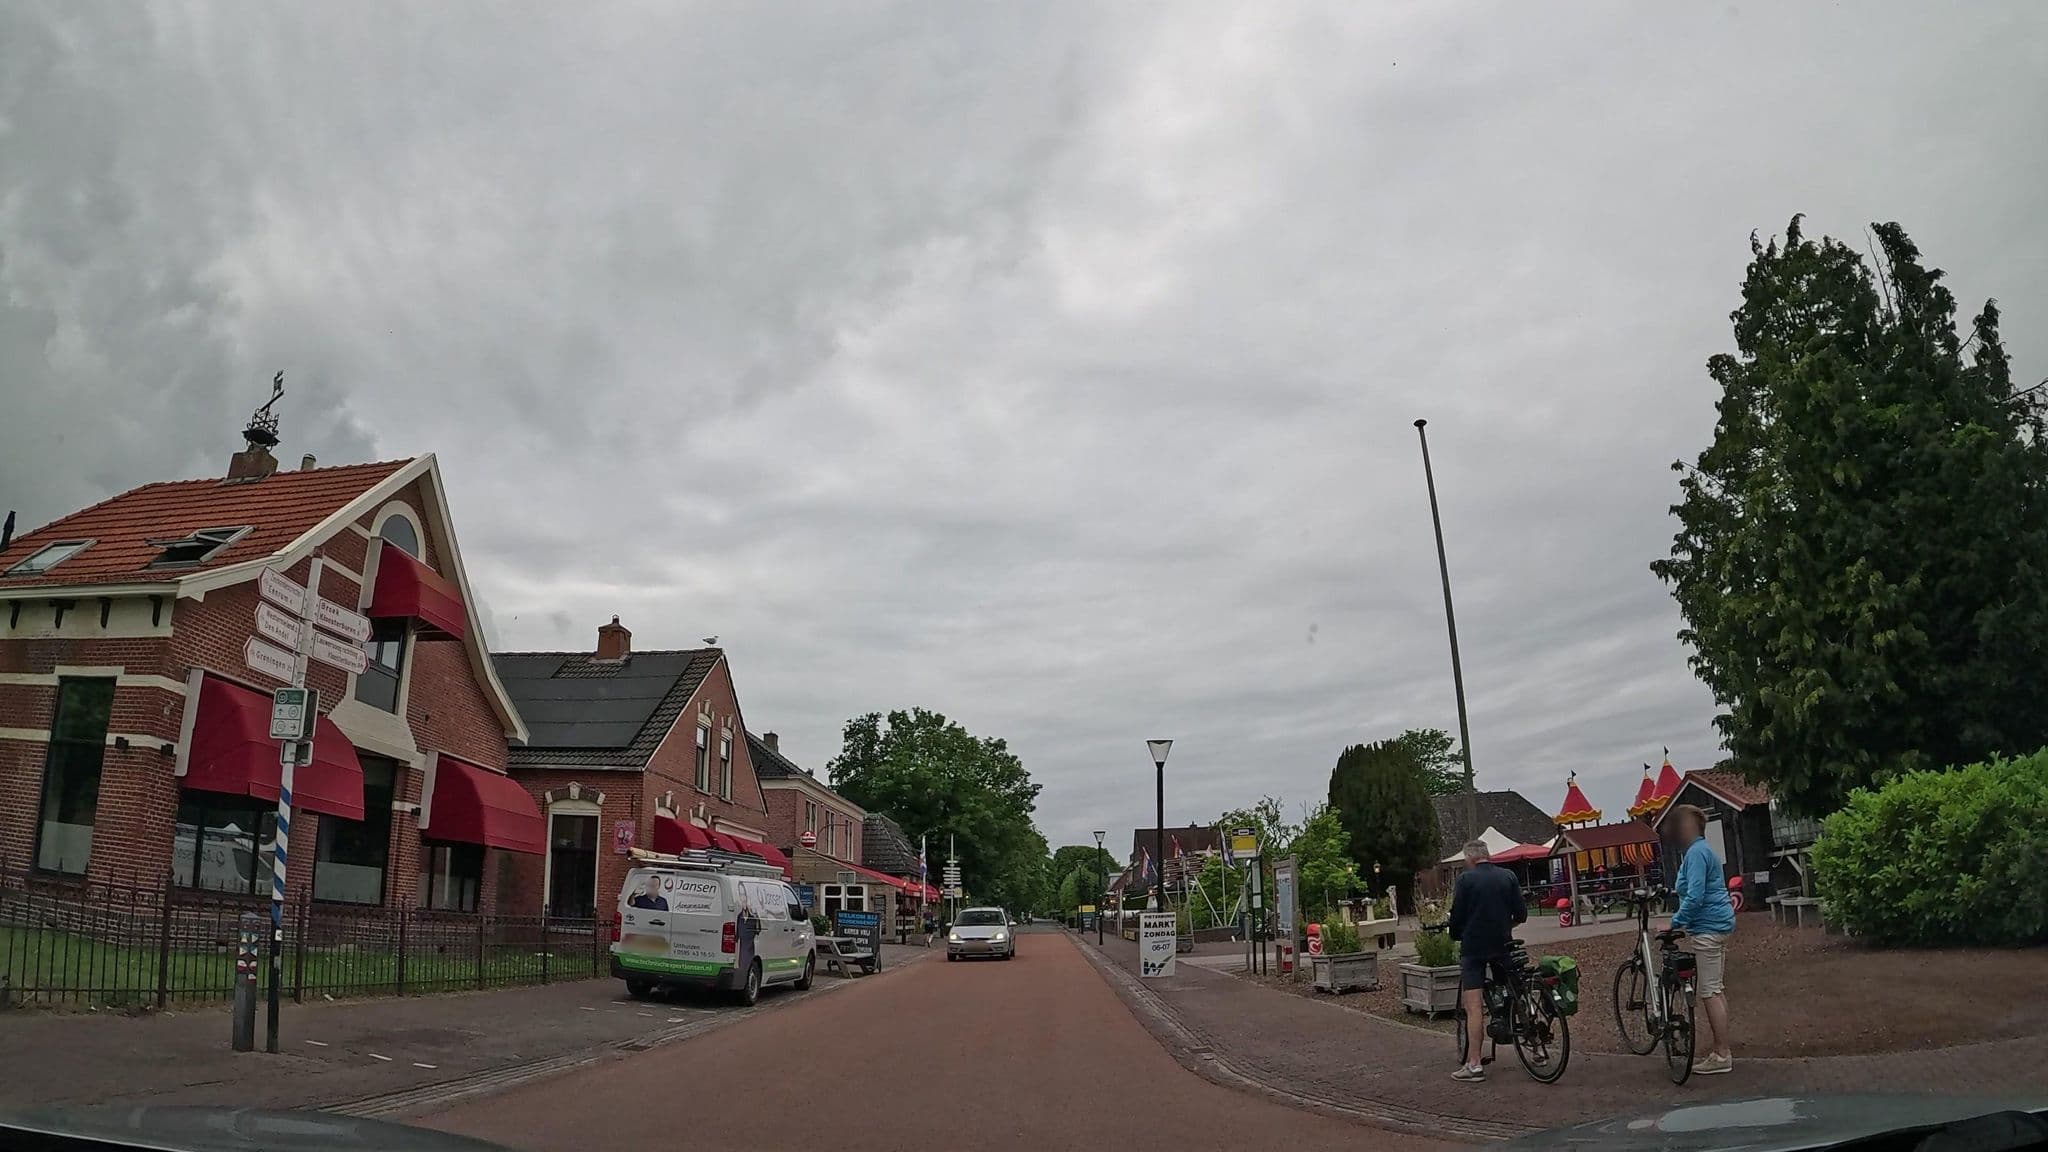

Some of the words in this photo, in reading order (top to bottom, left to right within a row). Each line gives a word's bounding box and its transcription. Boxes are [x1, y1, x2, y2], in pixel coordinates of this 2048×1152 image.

[321, 602, 339, 616] Broek
[320, 613, 356, 634] Kloosterburen
[256, 650, 286, 670] Groningen
[676, 879, 717, 893] Jansen
[1144, 930, 1175, 938] ZONDAG
[673, 942, 700, 950] Uithuizen
[1152, 943, 1170, 951] 06-07
